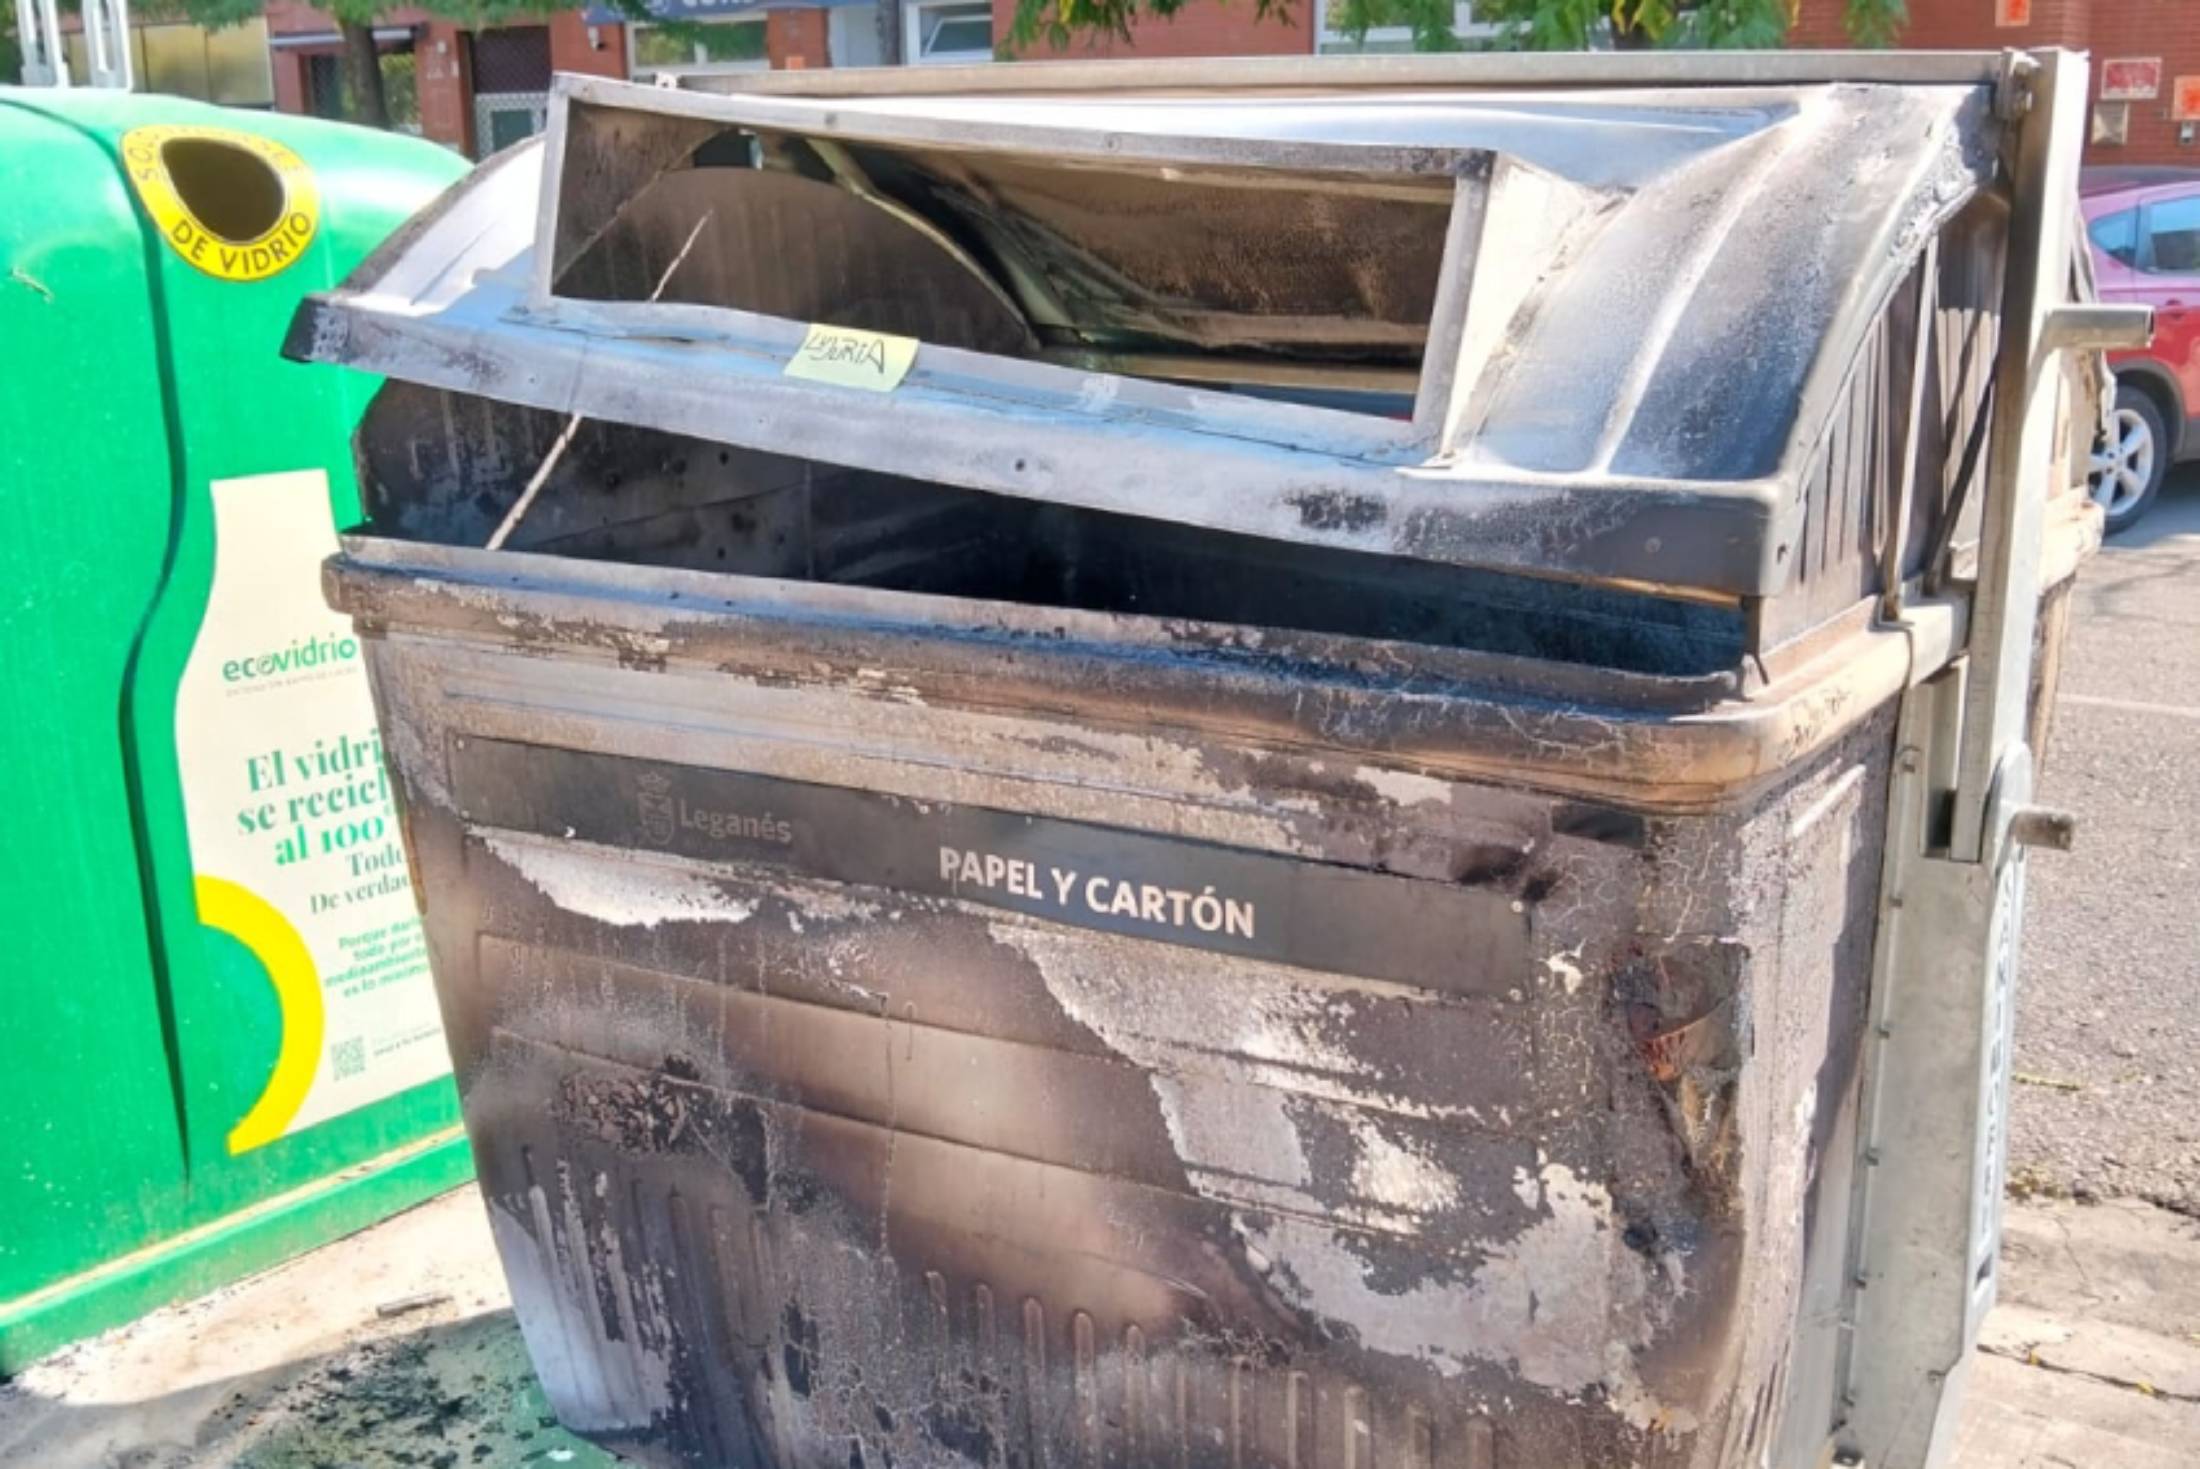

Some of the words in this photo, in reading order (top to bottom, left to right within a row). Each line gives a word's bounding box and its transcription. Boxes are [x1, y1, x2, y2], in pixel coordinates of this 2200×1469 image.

[171, 219, 209, 261] DE
[219, 211, 312, 275] VIDRIO
[222, 632, 357, 682] ecovidrio
[246, 750, 286, 792] El
[294, 728, 382, 781] vidri
[237, 801, 277, 836] se
[288, 766, 388, 823] recicl
[680, 799, 792, 843] Leganés
[274, 824, 309, 866] al
[320, 808, 390, 853] 100
[310, 891, 339, 915] De
[939, 846, 1044, 899] PAPEL
[1051, 867, 1078, 905] Y
[1085, 877, 1256, 939] CARTÓN
